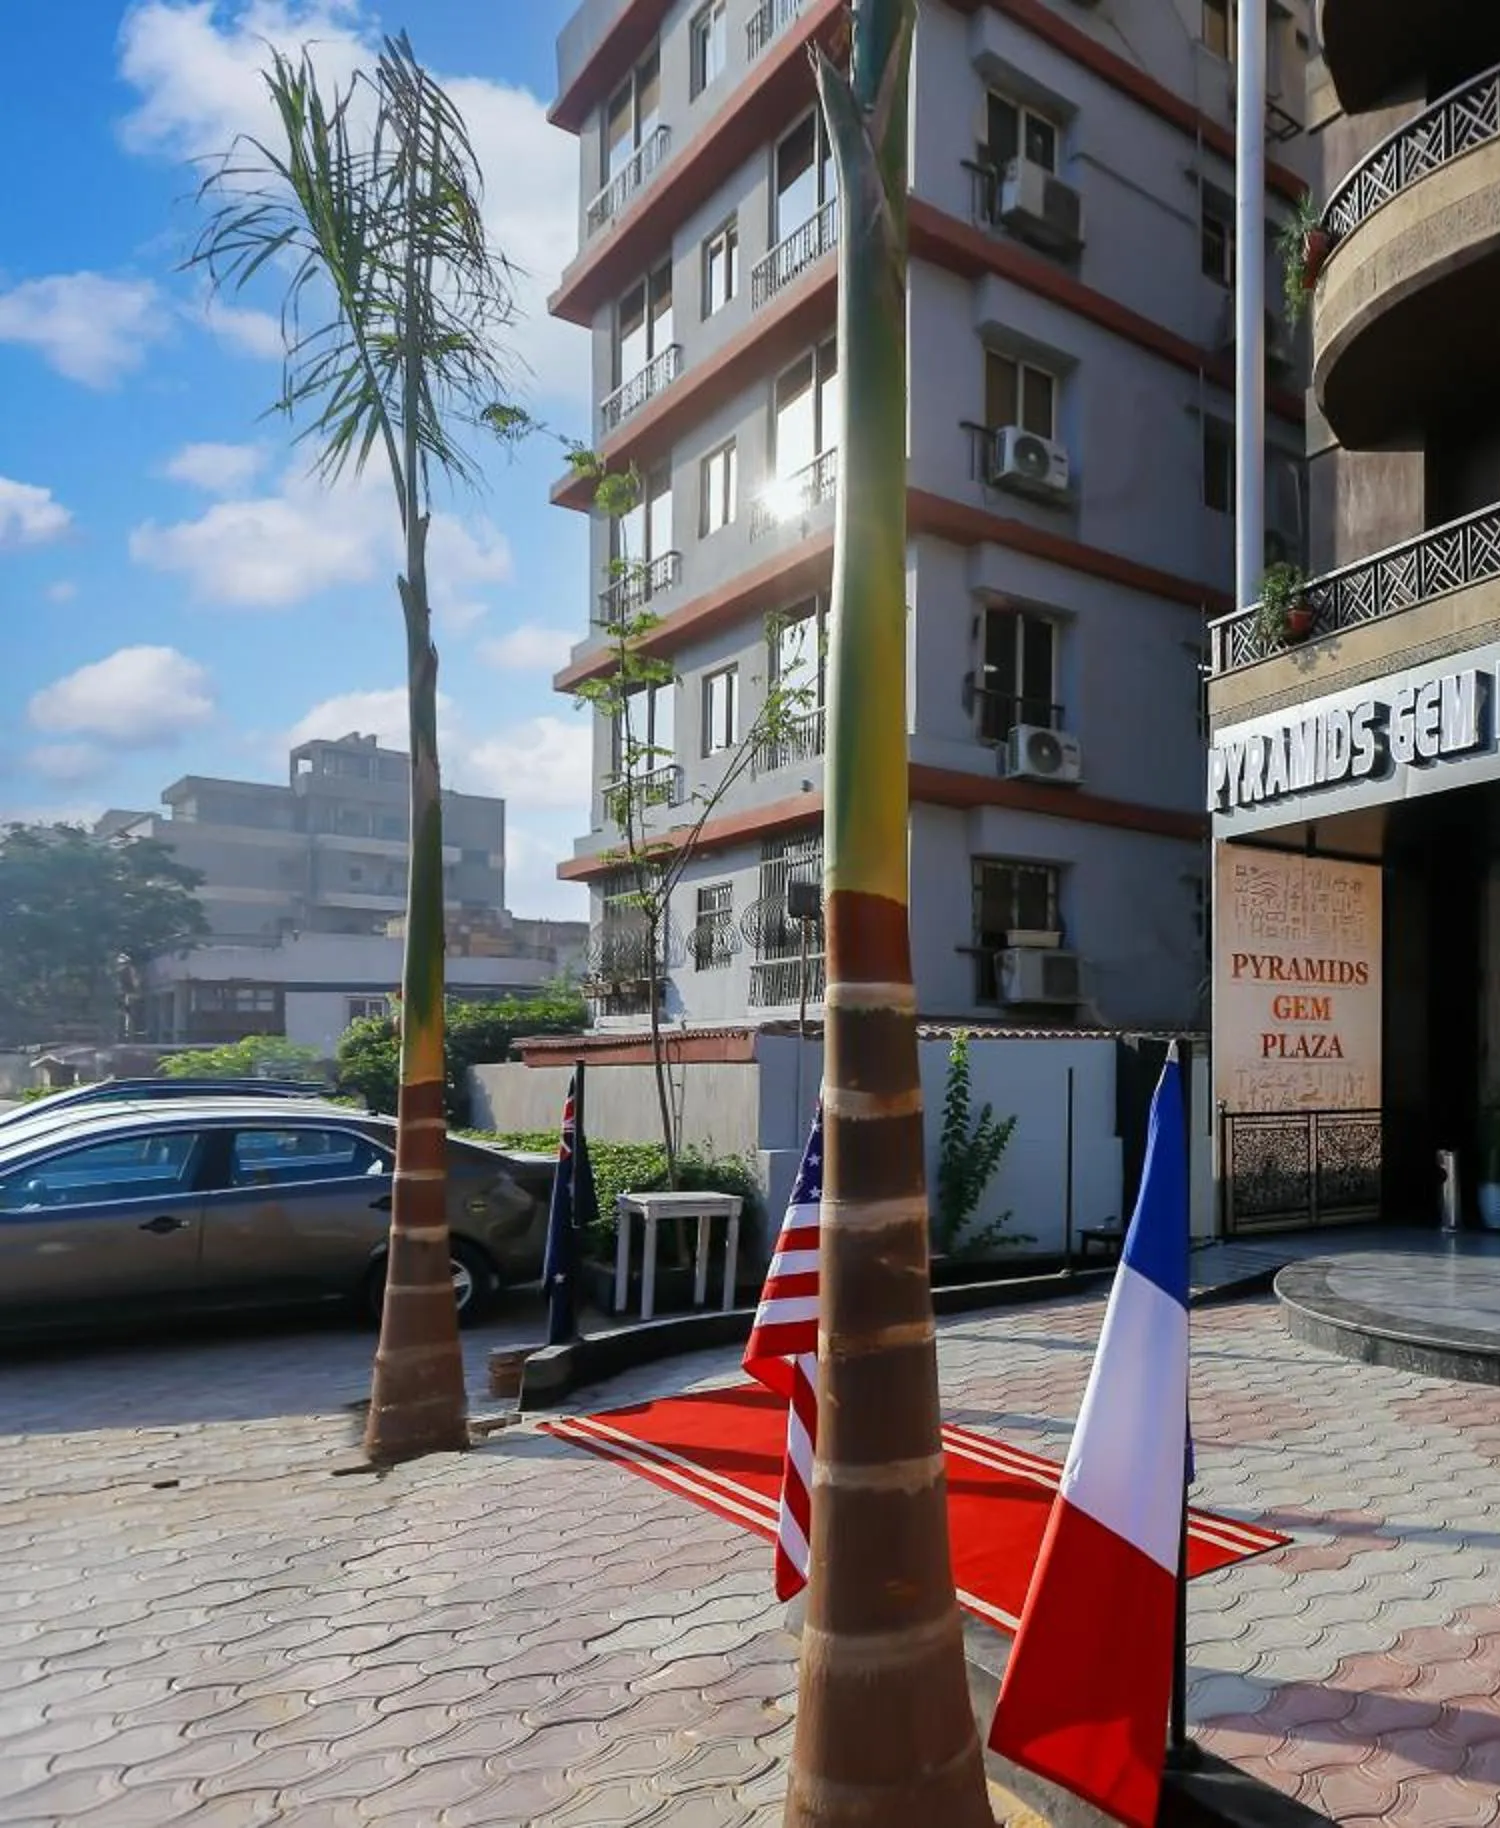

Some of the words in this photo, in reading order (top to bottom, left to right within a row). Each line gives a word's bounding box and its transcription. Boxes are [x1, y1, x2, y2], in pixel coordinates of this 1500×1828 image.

[1207, 700, 1376, 812] PYRAMIDS
[1389, 669, 1478, 764] GEM
[1231, 953, 1369, 986] PYRAMIDS
[1272, 994, 1332, 1021] GEM
[1260, 1033, 1344, 1059] PLAZA
